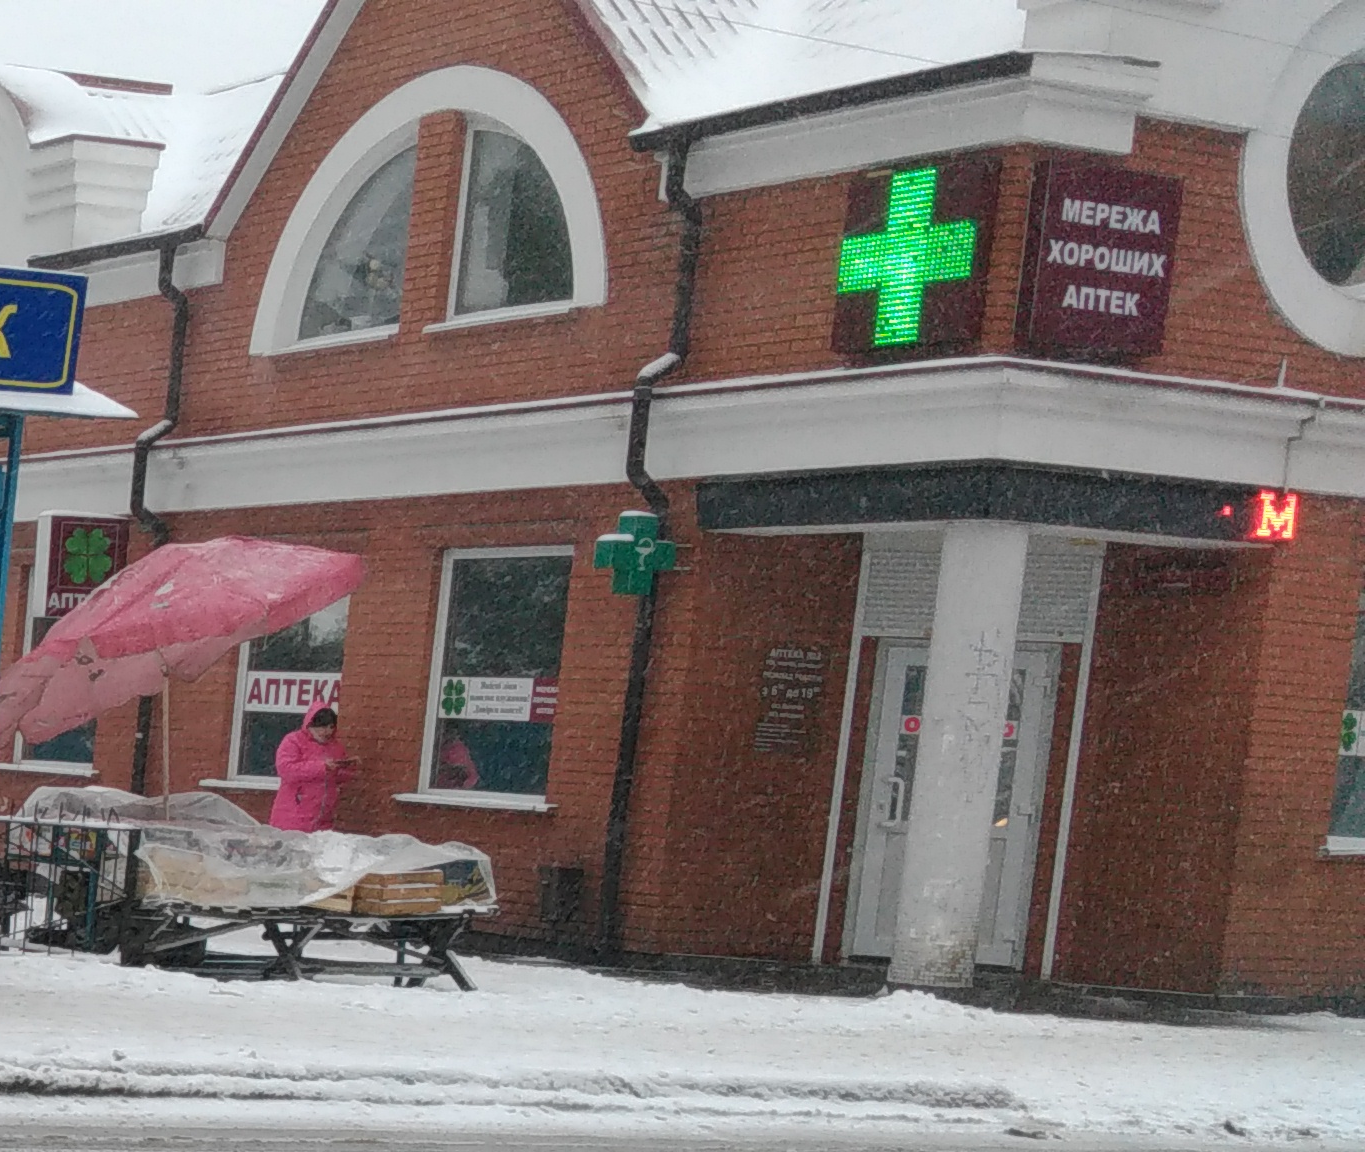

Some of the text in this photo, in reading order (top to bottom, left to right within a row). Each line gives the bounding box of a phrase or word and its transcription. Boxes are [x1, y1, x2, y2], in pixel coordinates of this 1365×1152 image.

[1061, 198, 1161, 235] МЕРЕЖА
[1047, 239, 1167, 278] ХОРОШИХ
[1062, 284, 1140, 317] АПТЕК
[48, 592, 86, 609] АПТ
[247, 677, 341, 706] АПТЕКА
